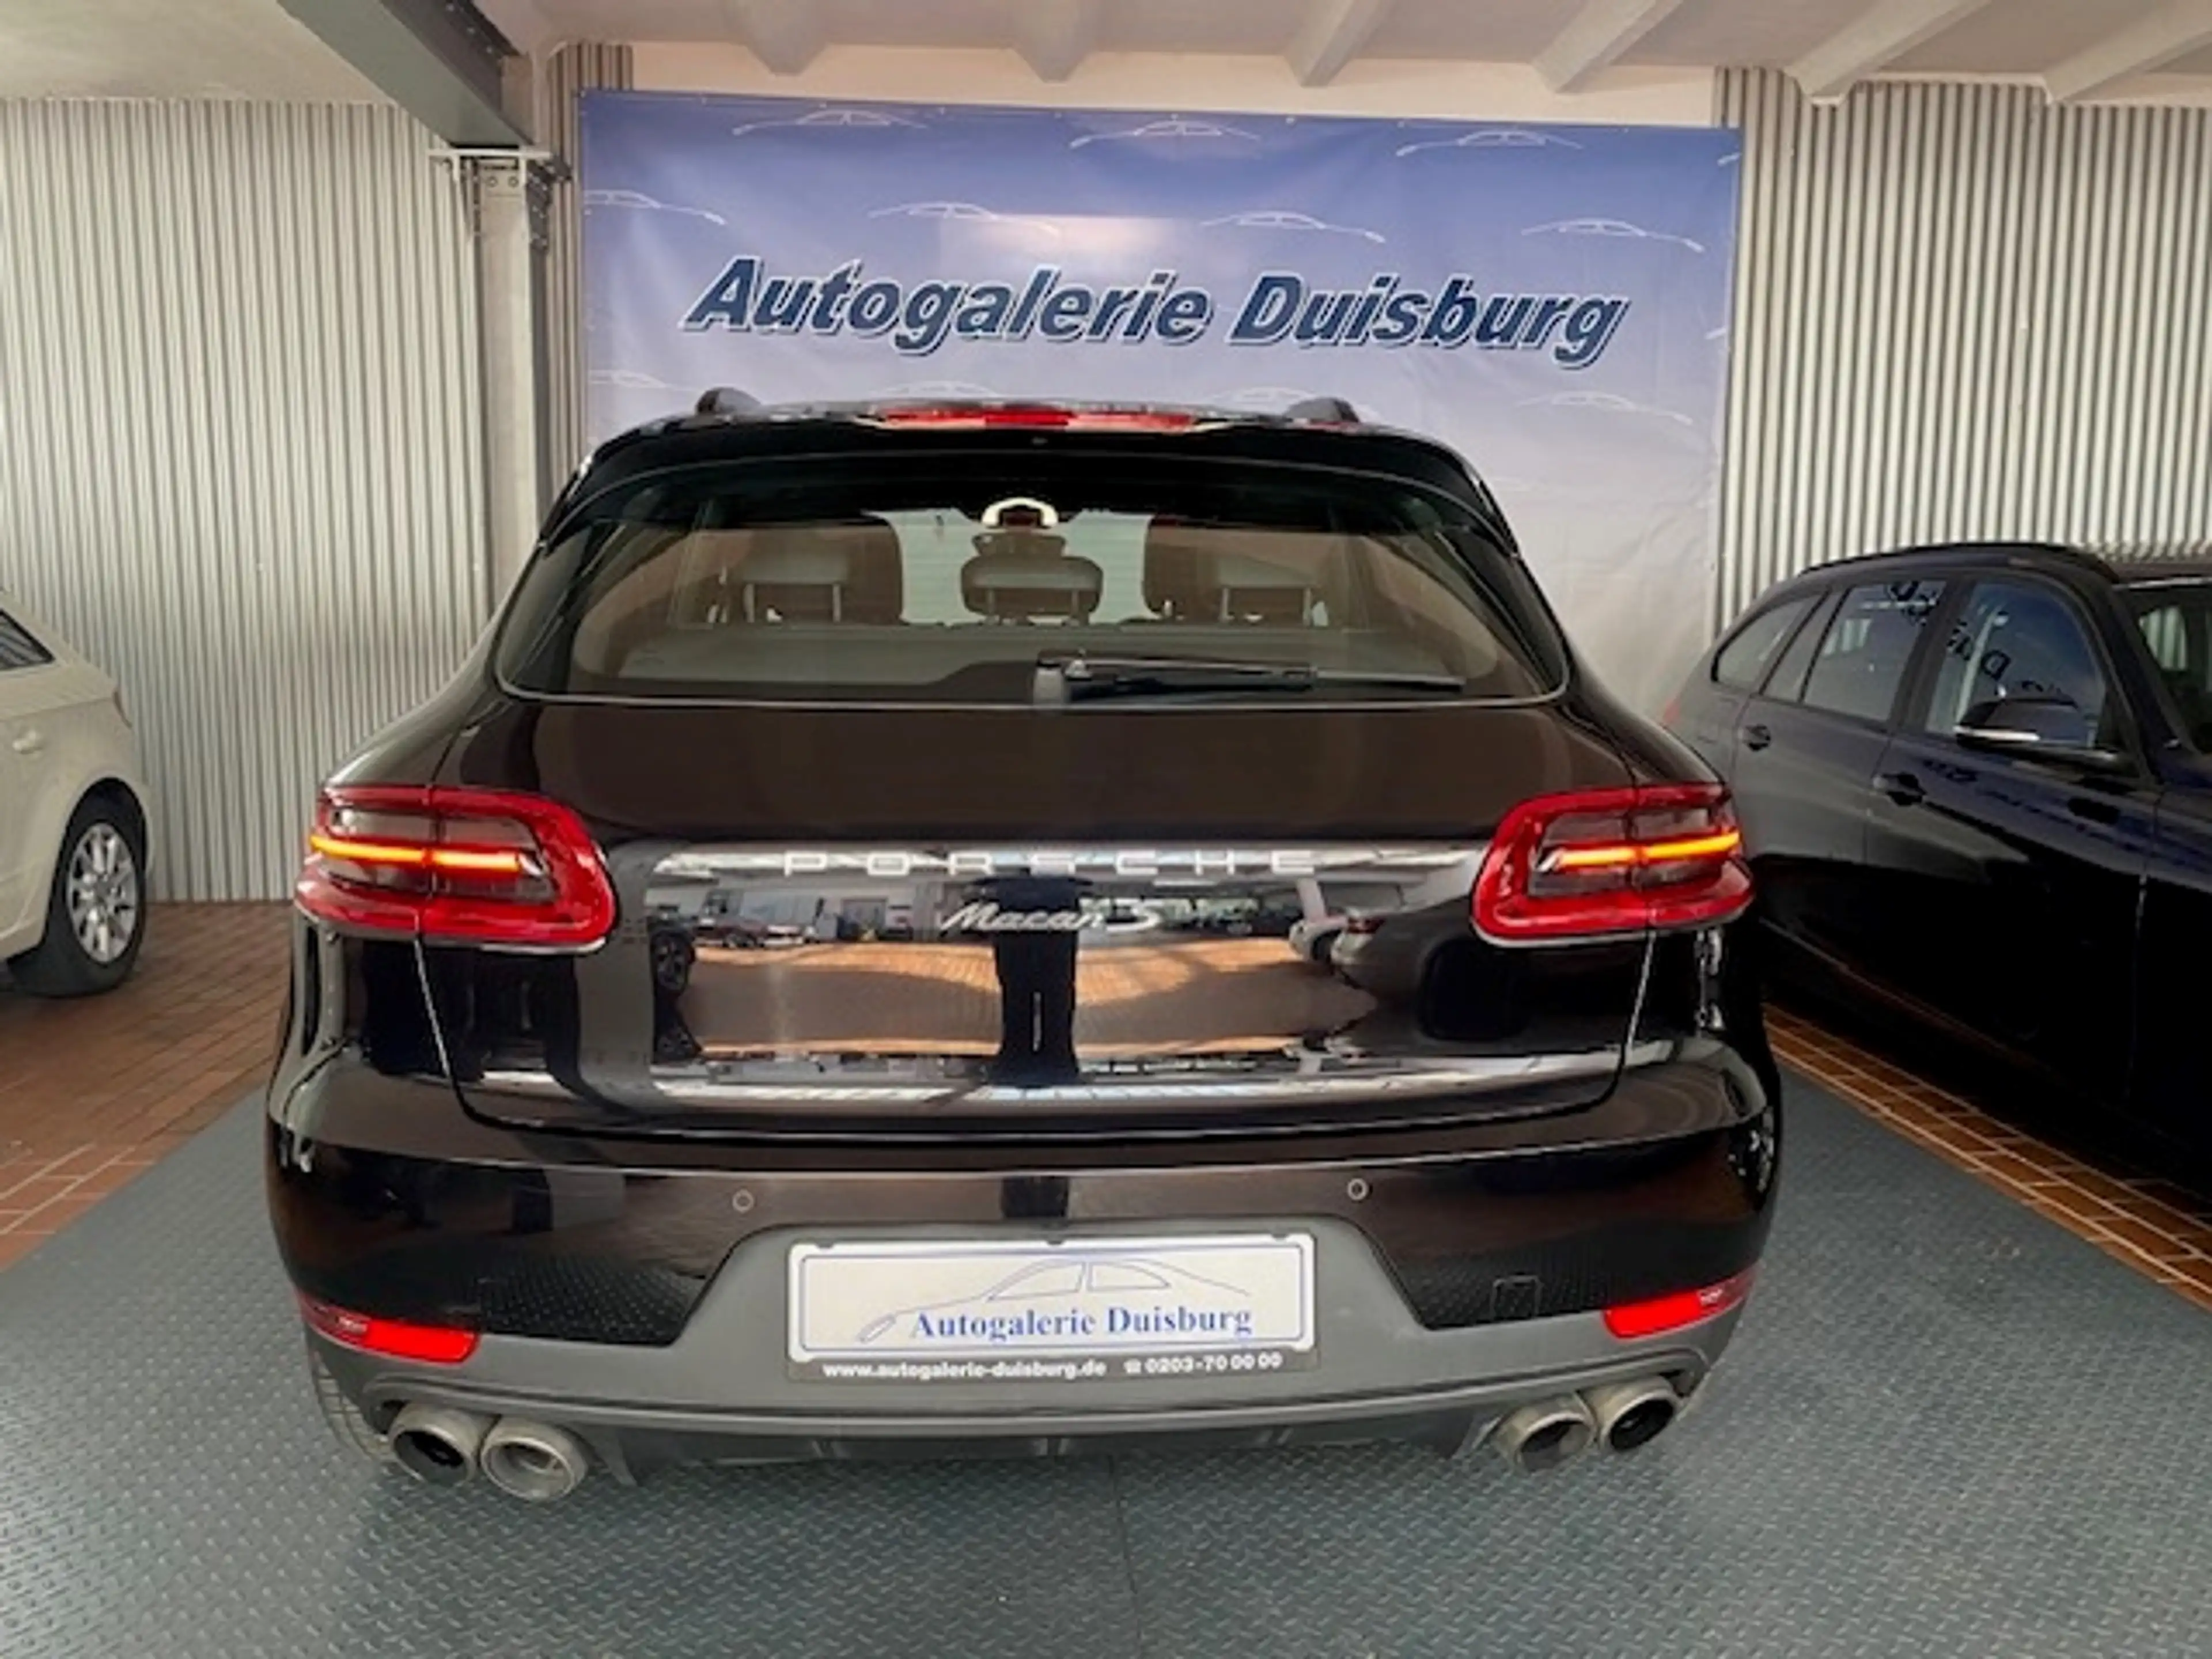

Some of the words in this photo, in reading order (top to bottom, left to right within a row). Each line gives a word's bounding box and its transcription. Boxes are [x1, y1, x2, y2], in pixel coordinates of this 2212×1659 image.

[677, 255, 1214, 358] Autogalerie
[1226, 271, 1630, 369] Duisburg
[784, 850, 1316, 877] PORSCHE
[939, 901, 1104, 932] Macan
[1105, 898, 1161, 932] S
[910, 1309, 1096, 1343] Autogalerie
[1108, 1305, 1252, 1336] Duisburg
[822, 1358, 1107, 1380] www.autogalerie-duisburg.de
